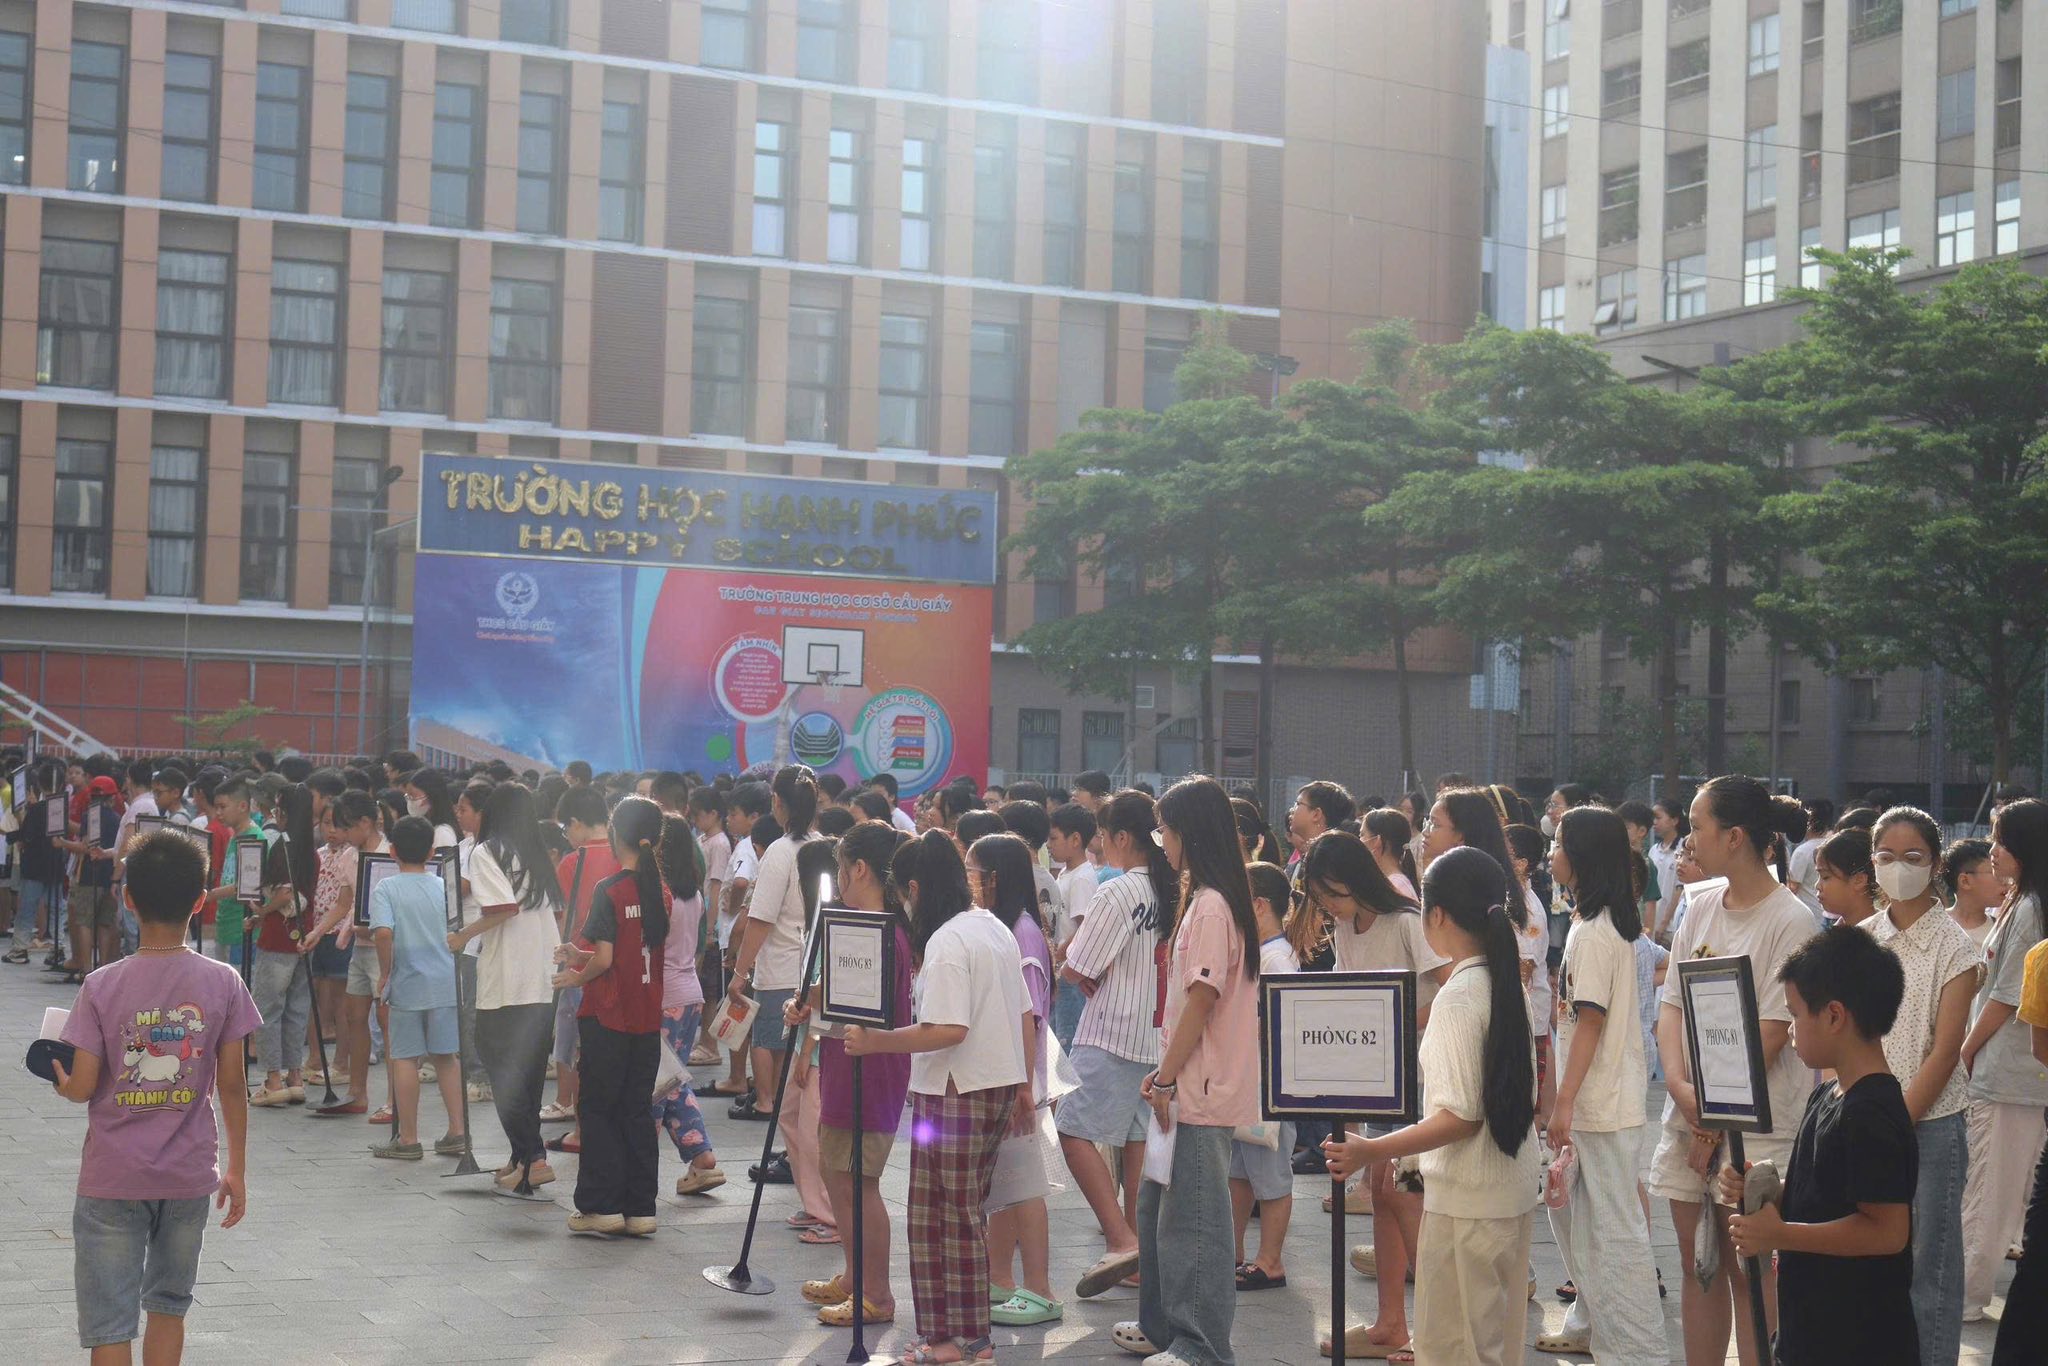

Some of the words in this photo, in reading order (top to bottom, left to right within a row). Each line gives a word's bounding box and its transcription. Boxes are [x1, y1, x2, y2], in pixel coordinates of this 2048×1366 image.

[440, 464, 623, 519] TRƯỜNG
[637, 483, 727, 535] HỌC
[518, 524, 690, 558] HAPPY
[713, 537, 906, 573] SCHOOL
[719, 586, 773, 602] TRƯỜNG
[776, 591, 819, 606] TRUNG
[822, 592, 849, 609] HỌC
[864, 957, 872, 970] 83
[1302, 1025, 1358, 1045] PHÒNG
[1361, 1030, 1377, 1045] 82
[1705, 1024, 1730, 1046] PHÒNG
[1730, 1028, 1738, 1046] 81
[115, 1088, 168, 1107] THÀNH
